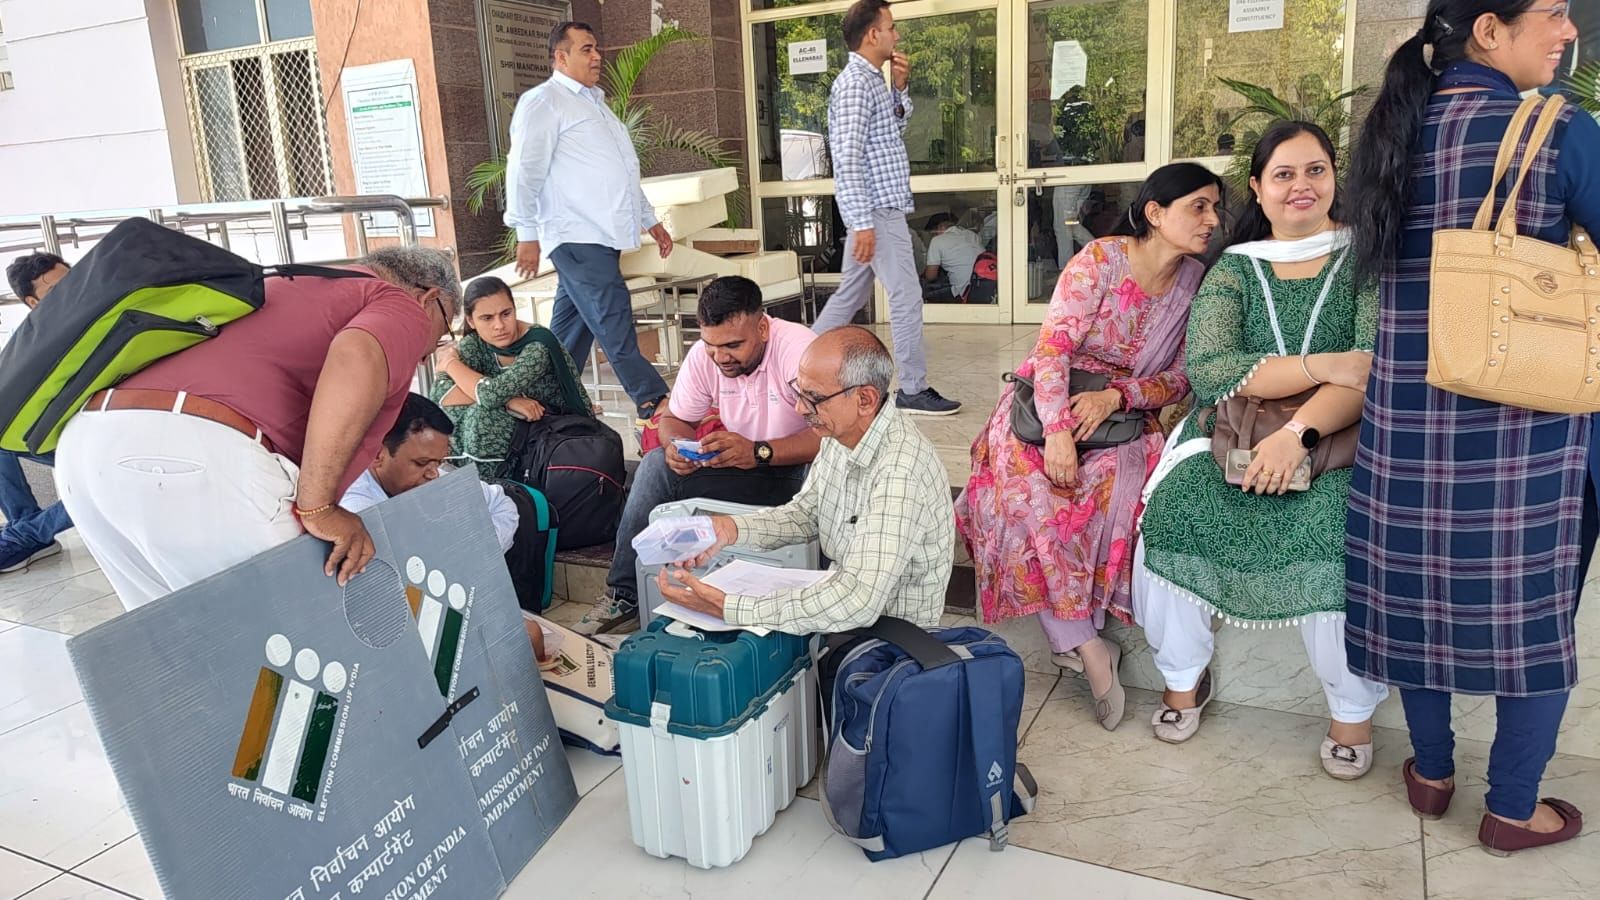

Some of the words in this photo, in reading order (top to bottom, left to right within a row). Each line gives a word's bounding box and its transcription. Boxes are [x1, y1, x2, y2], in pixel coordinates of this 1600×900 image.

[506, 26, 535, 38] AMBEDKAR
[1235, 13, 1276, 23] CONSTITUENCY
[500, 60, 515, 70] SHRI
[793, 54, 823, 63] ELLENABAD
[587, 665, 597, 688] GENERAL
[487, 700, 519, 734] आयोग
[330, 705, 350, 769] COMMISSION
[227, 782, 250, 801] भारत
[252, 787, 284, 813] निर्वाचन
[287, 802, 314, 821] आयोग
[310, 834, 369, 892] निर्वाचन
[373, 794, 416, 838] आयोग
[416, 854, 433, 878] OF
[433, 824, 467, 863] INDIA
[346, 828, 414, 894] कम्पार्टमेंट
[407, 863, 448, 900] MENT
